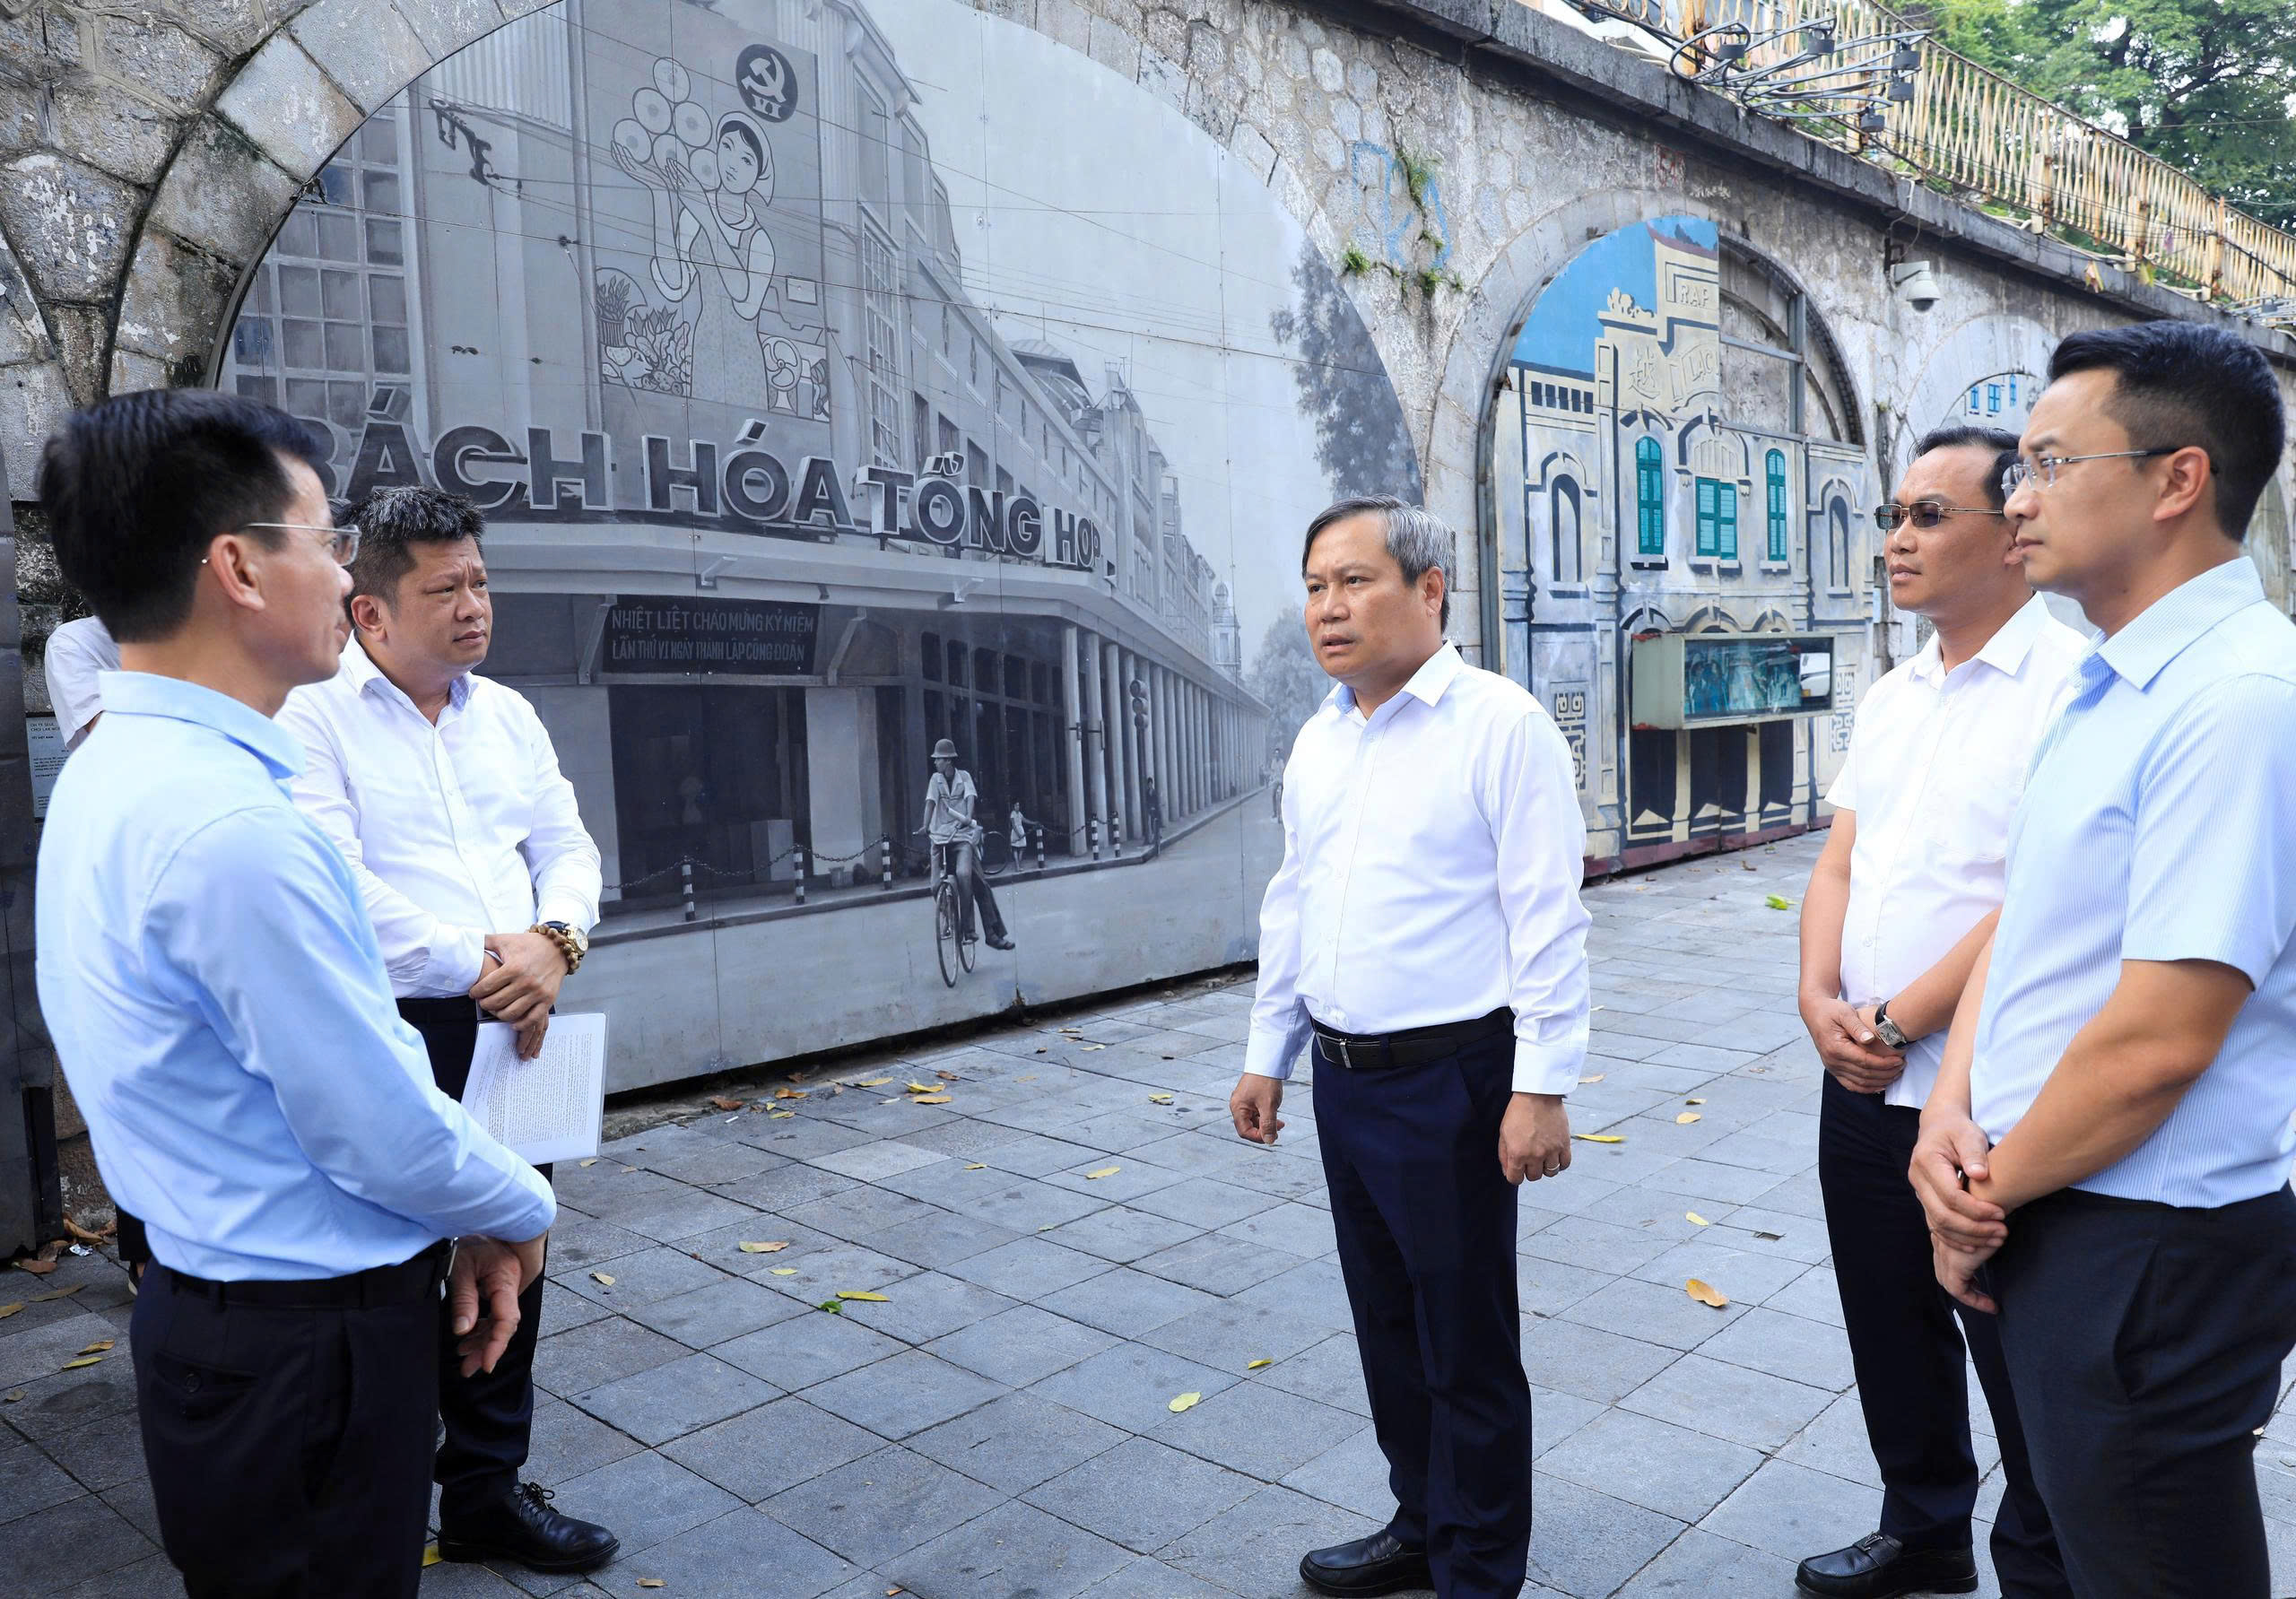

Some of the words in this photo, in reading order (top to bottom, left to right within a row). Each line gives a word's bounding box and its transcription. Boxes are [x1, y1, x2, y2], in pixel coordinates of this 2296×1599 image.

[641, 418, 857, 532] HÓA
[857, 451, 1042, 557] TỔNG
[612, 604, 653, 633] NHIỆT
[657, 604, 690, 633] LIỆT
[783, 611, 814, 637] NIỆM
[638, 633, 657, 660] THỨ
